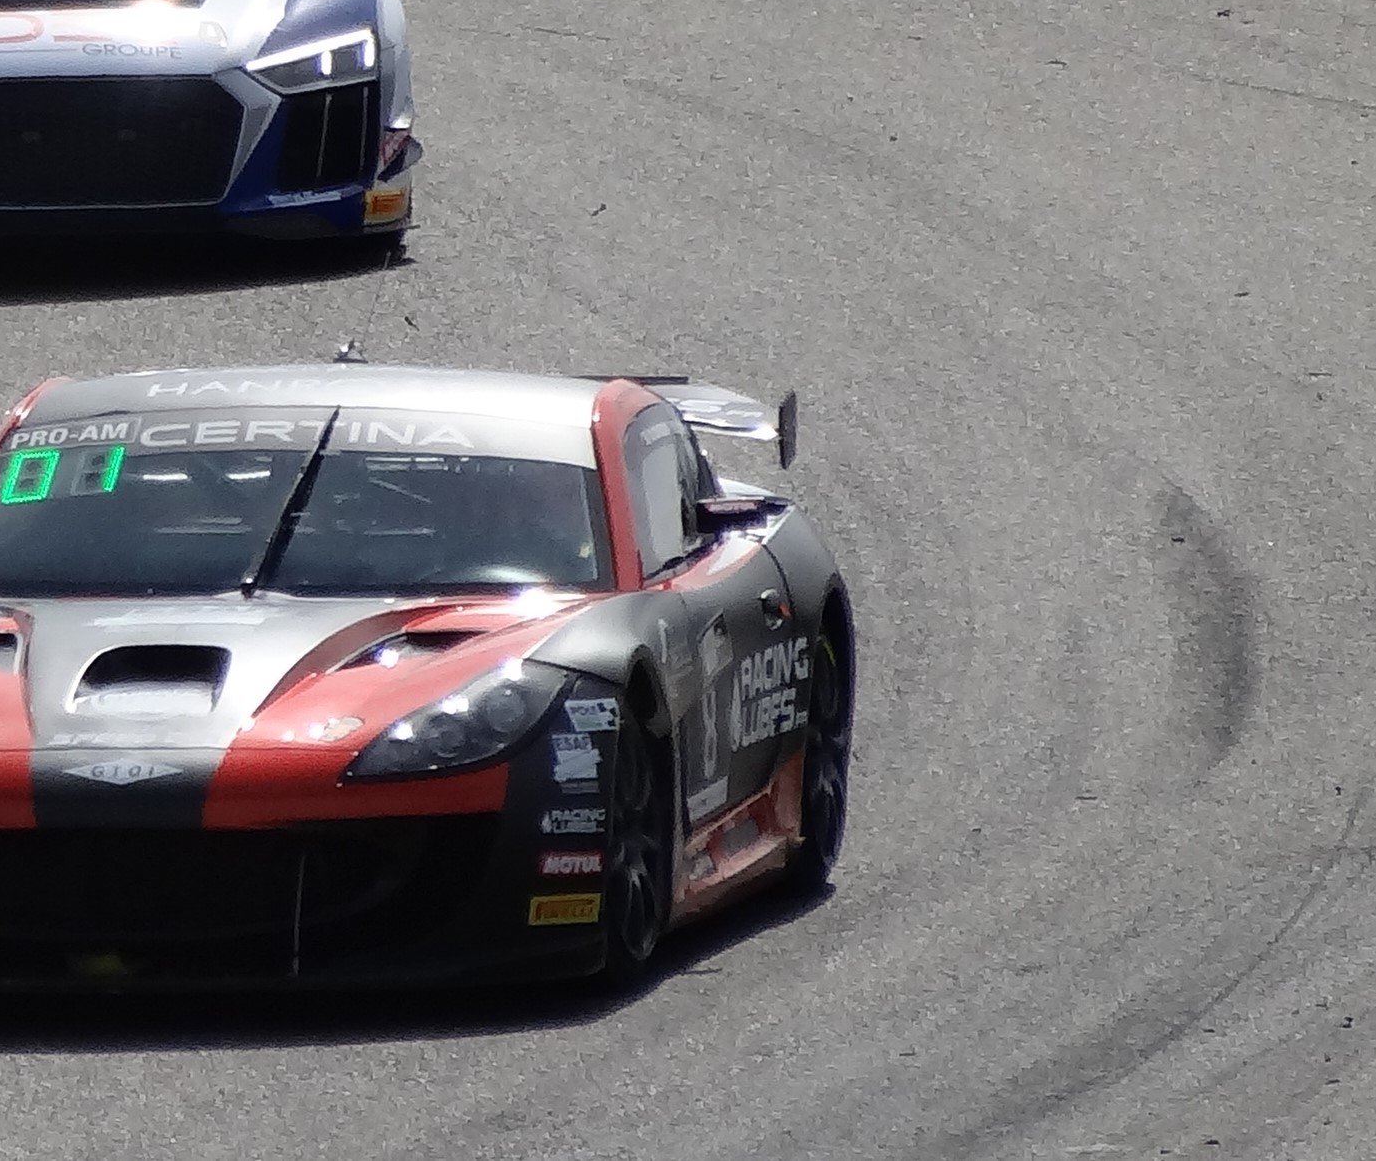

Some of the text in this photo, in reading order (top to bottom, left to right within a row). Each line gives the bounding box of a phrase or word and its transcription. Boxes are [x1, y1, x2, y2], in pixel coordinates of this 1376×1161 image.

[10, 422, 129, 449] PRO-AM
[140, 419, 476, 450] CERTINA
[0, 445, 126, 506] 01
[741, 636, 809, 700] RACING
[551, 809, 606, 821] RACING
[543, 855, 602, 874] MOTUL
